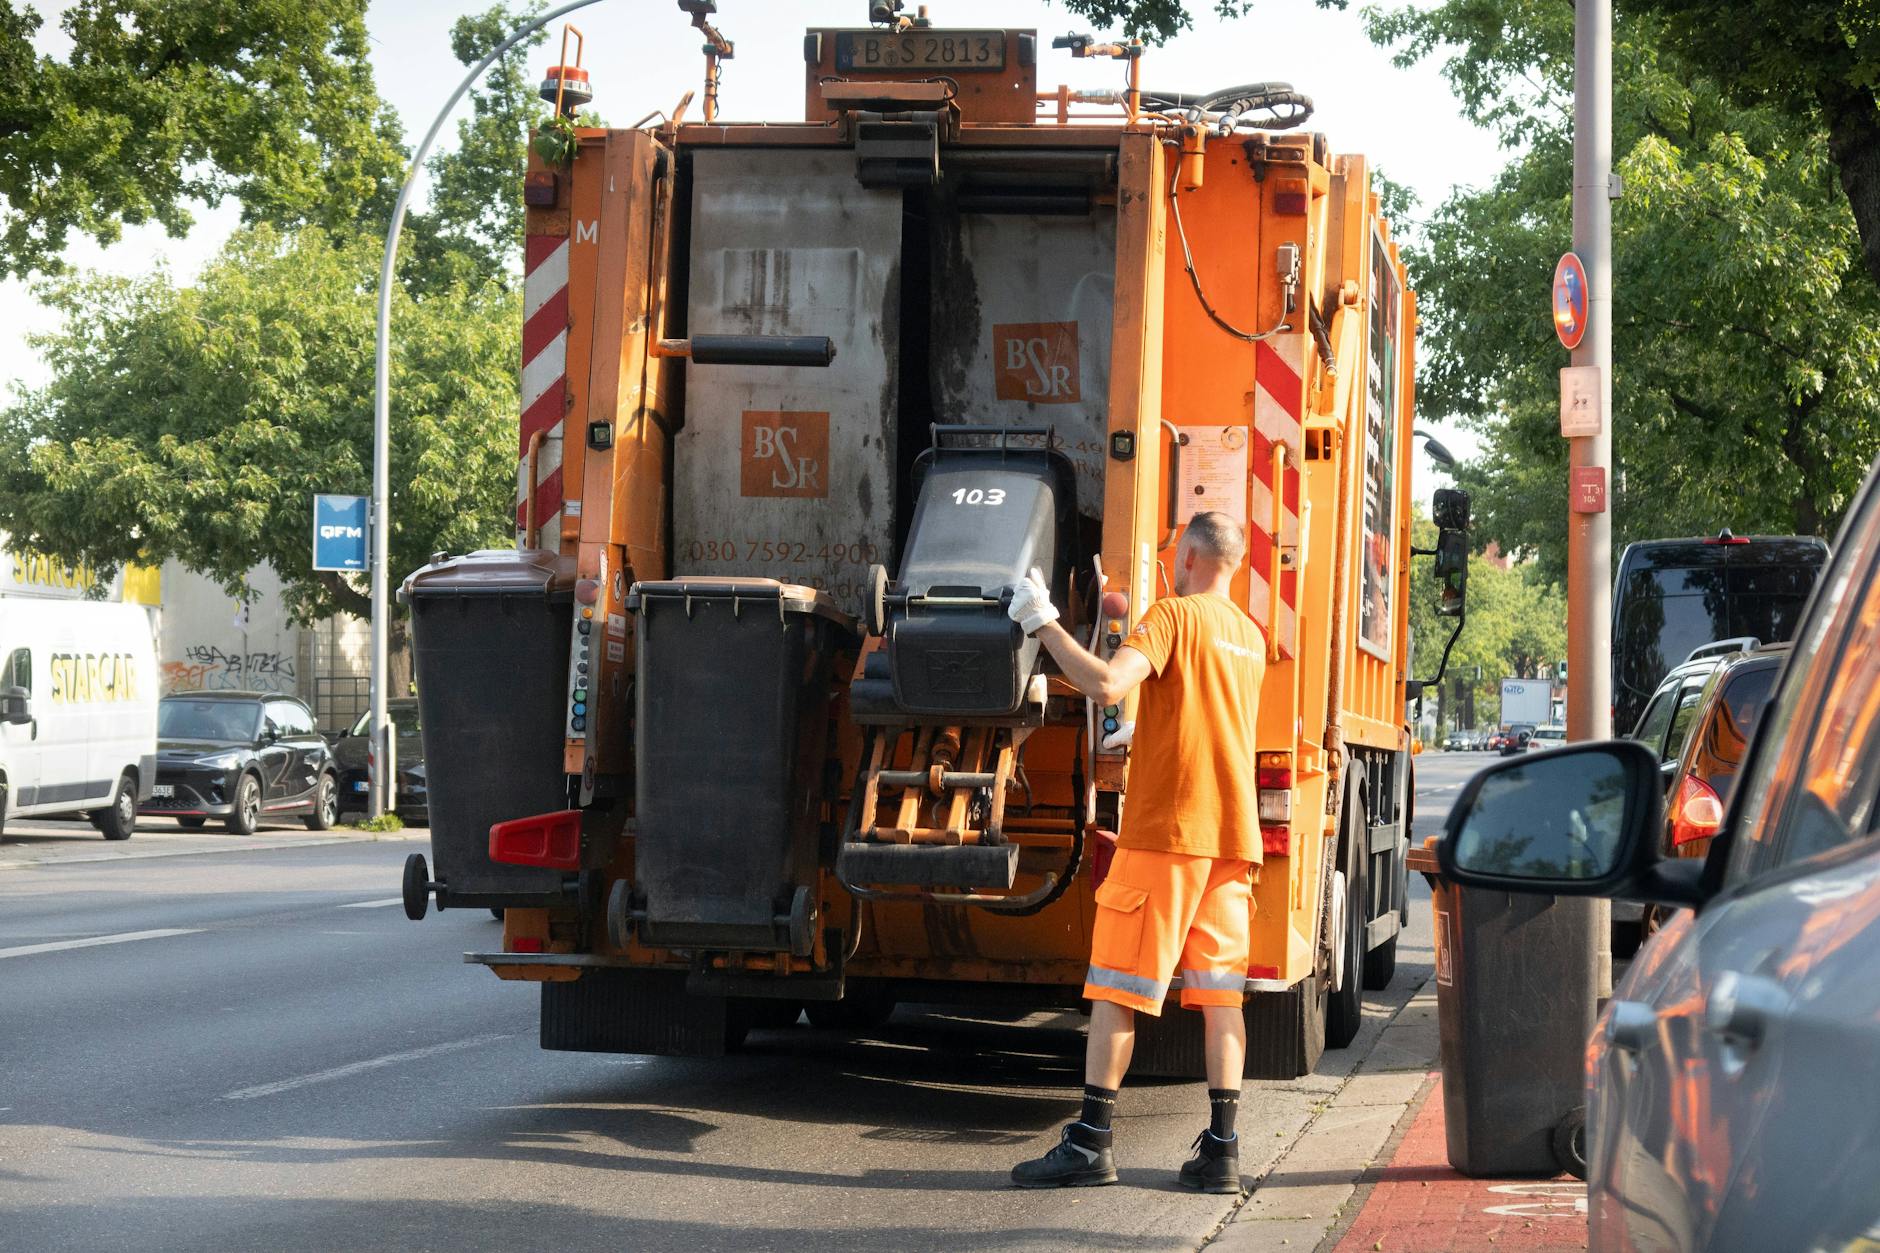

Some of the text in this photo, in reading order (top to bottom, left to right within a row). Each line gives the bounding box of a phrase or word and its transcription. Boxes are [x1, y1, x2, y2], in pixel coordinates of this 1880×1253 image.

[865, 38, 990, 63] B S 2813
[576, 219, 597, 244] M
[1005, 337, 1074, 396] BSR
[752, 426, 820, 489] BSR
[952, 488, 1007, 505] 103
[320, 525, 362, 539] QFM
[690, 540, 879, 566] 030 7592-4900
[50, 653, 138, 704] STARCAR
